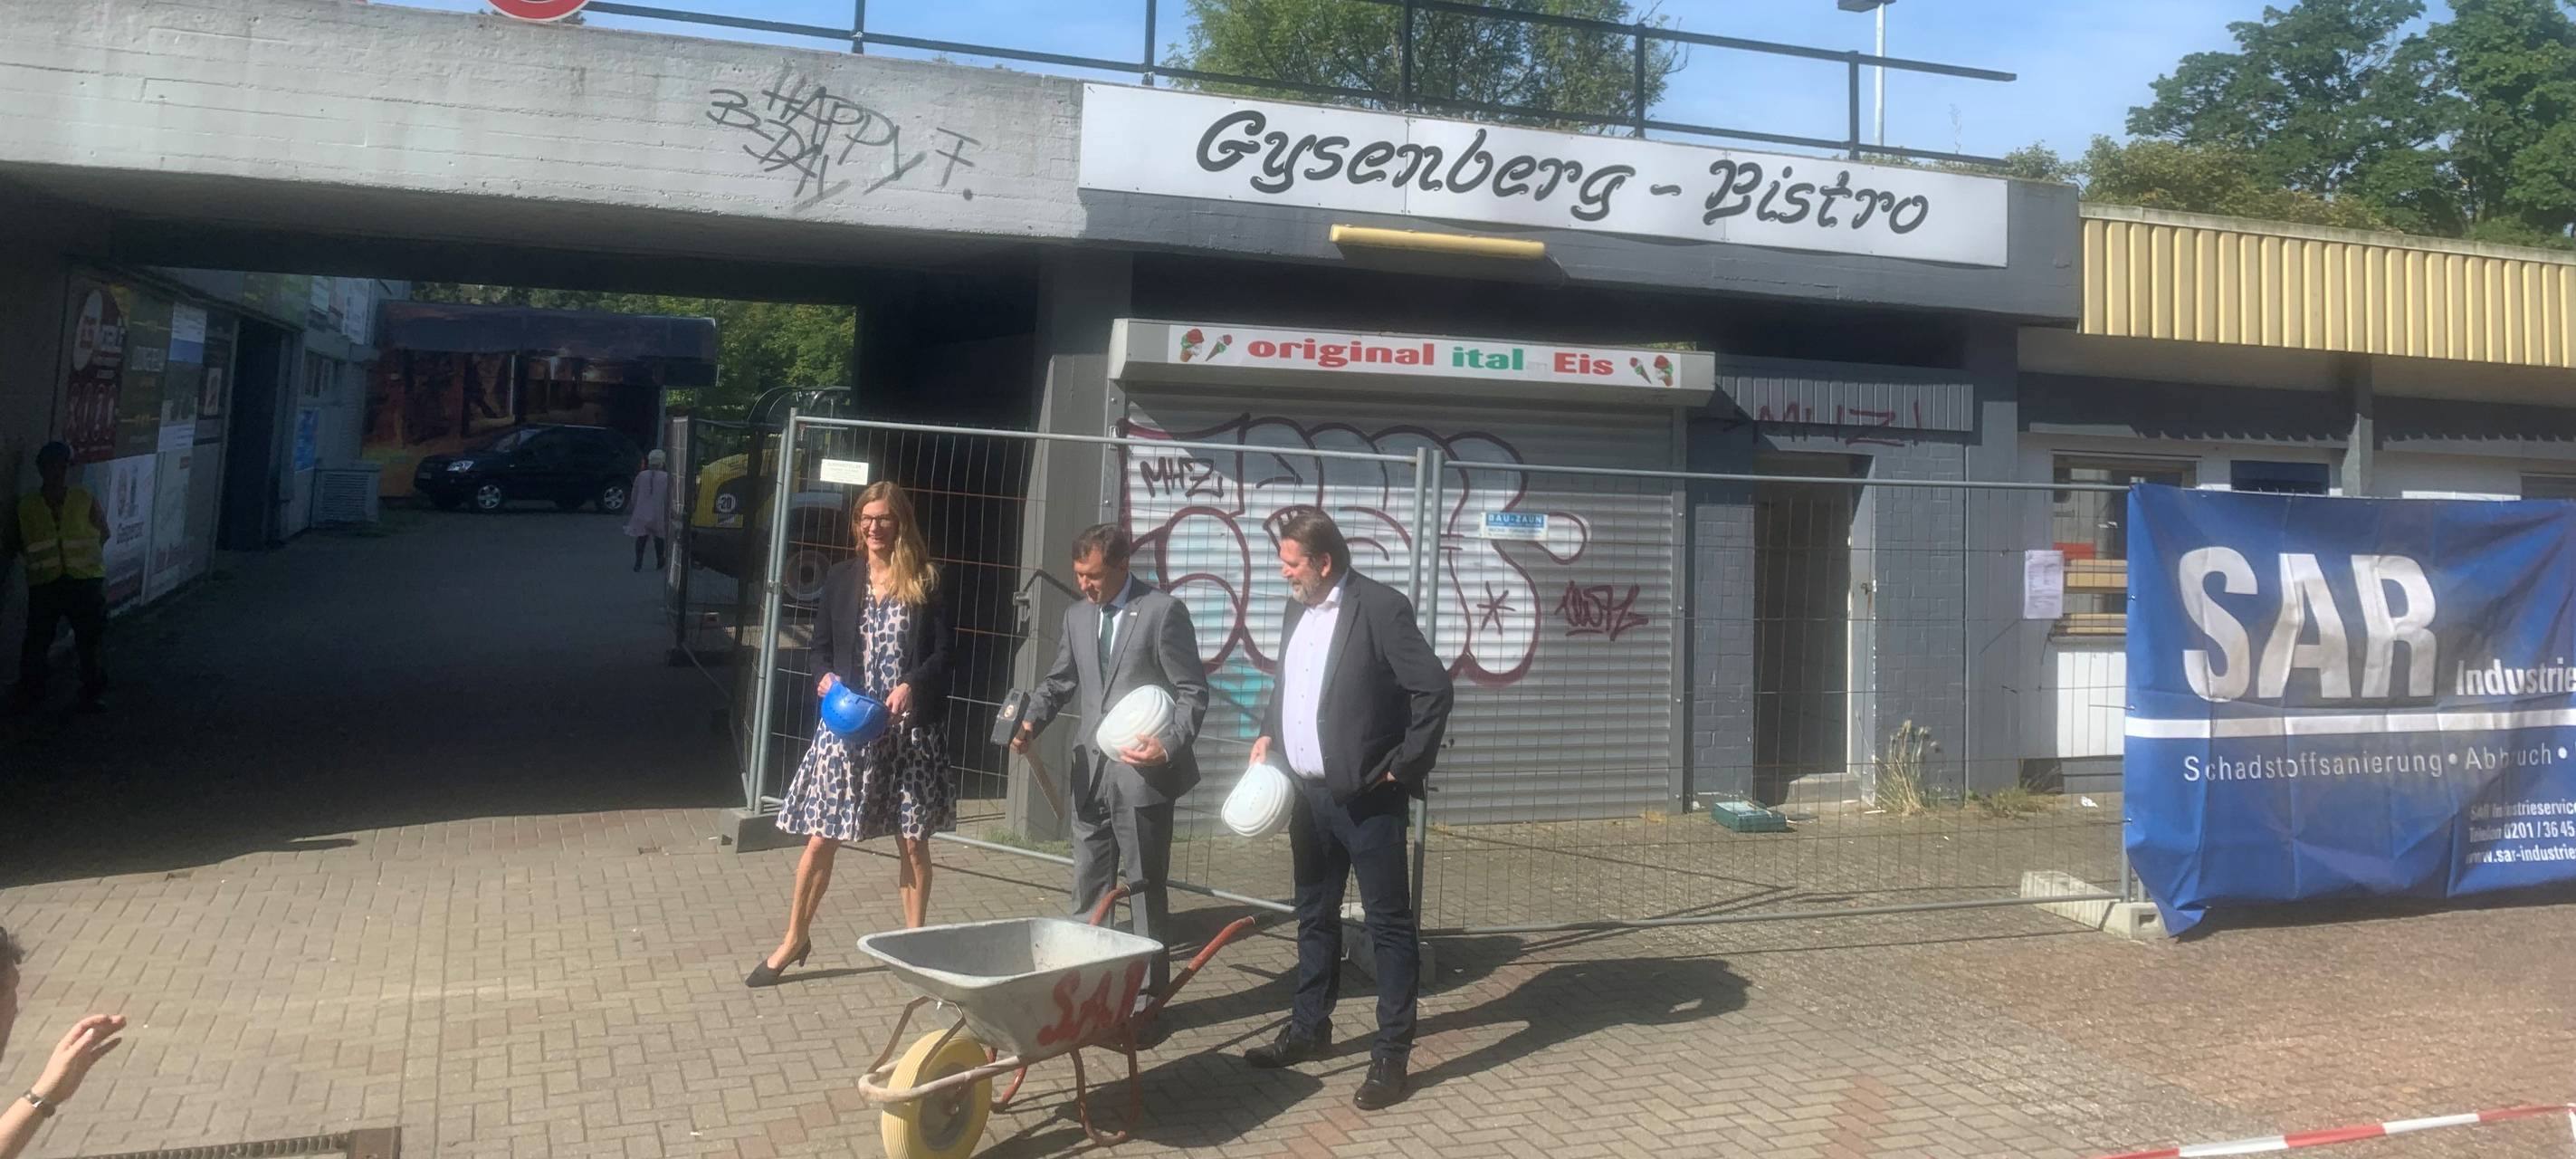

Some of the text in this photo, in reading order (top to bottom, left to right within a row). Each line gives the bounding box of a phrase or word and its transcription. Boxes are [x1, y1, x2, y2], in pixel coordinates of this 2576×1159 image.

[1197, 110, 1636, 221] Gysenberg
[1703, 159, 1929, 235] Bistro
[1247, 338, 1614, 376] original ital Eis
[1488, 513, 1543, 522] BAU-ZAUN
[2178, 546, 2438, 703] SAR
[2183, 751, 2443, 782] Schadstoffsanierung
